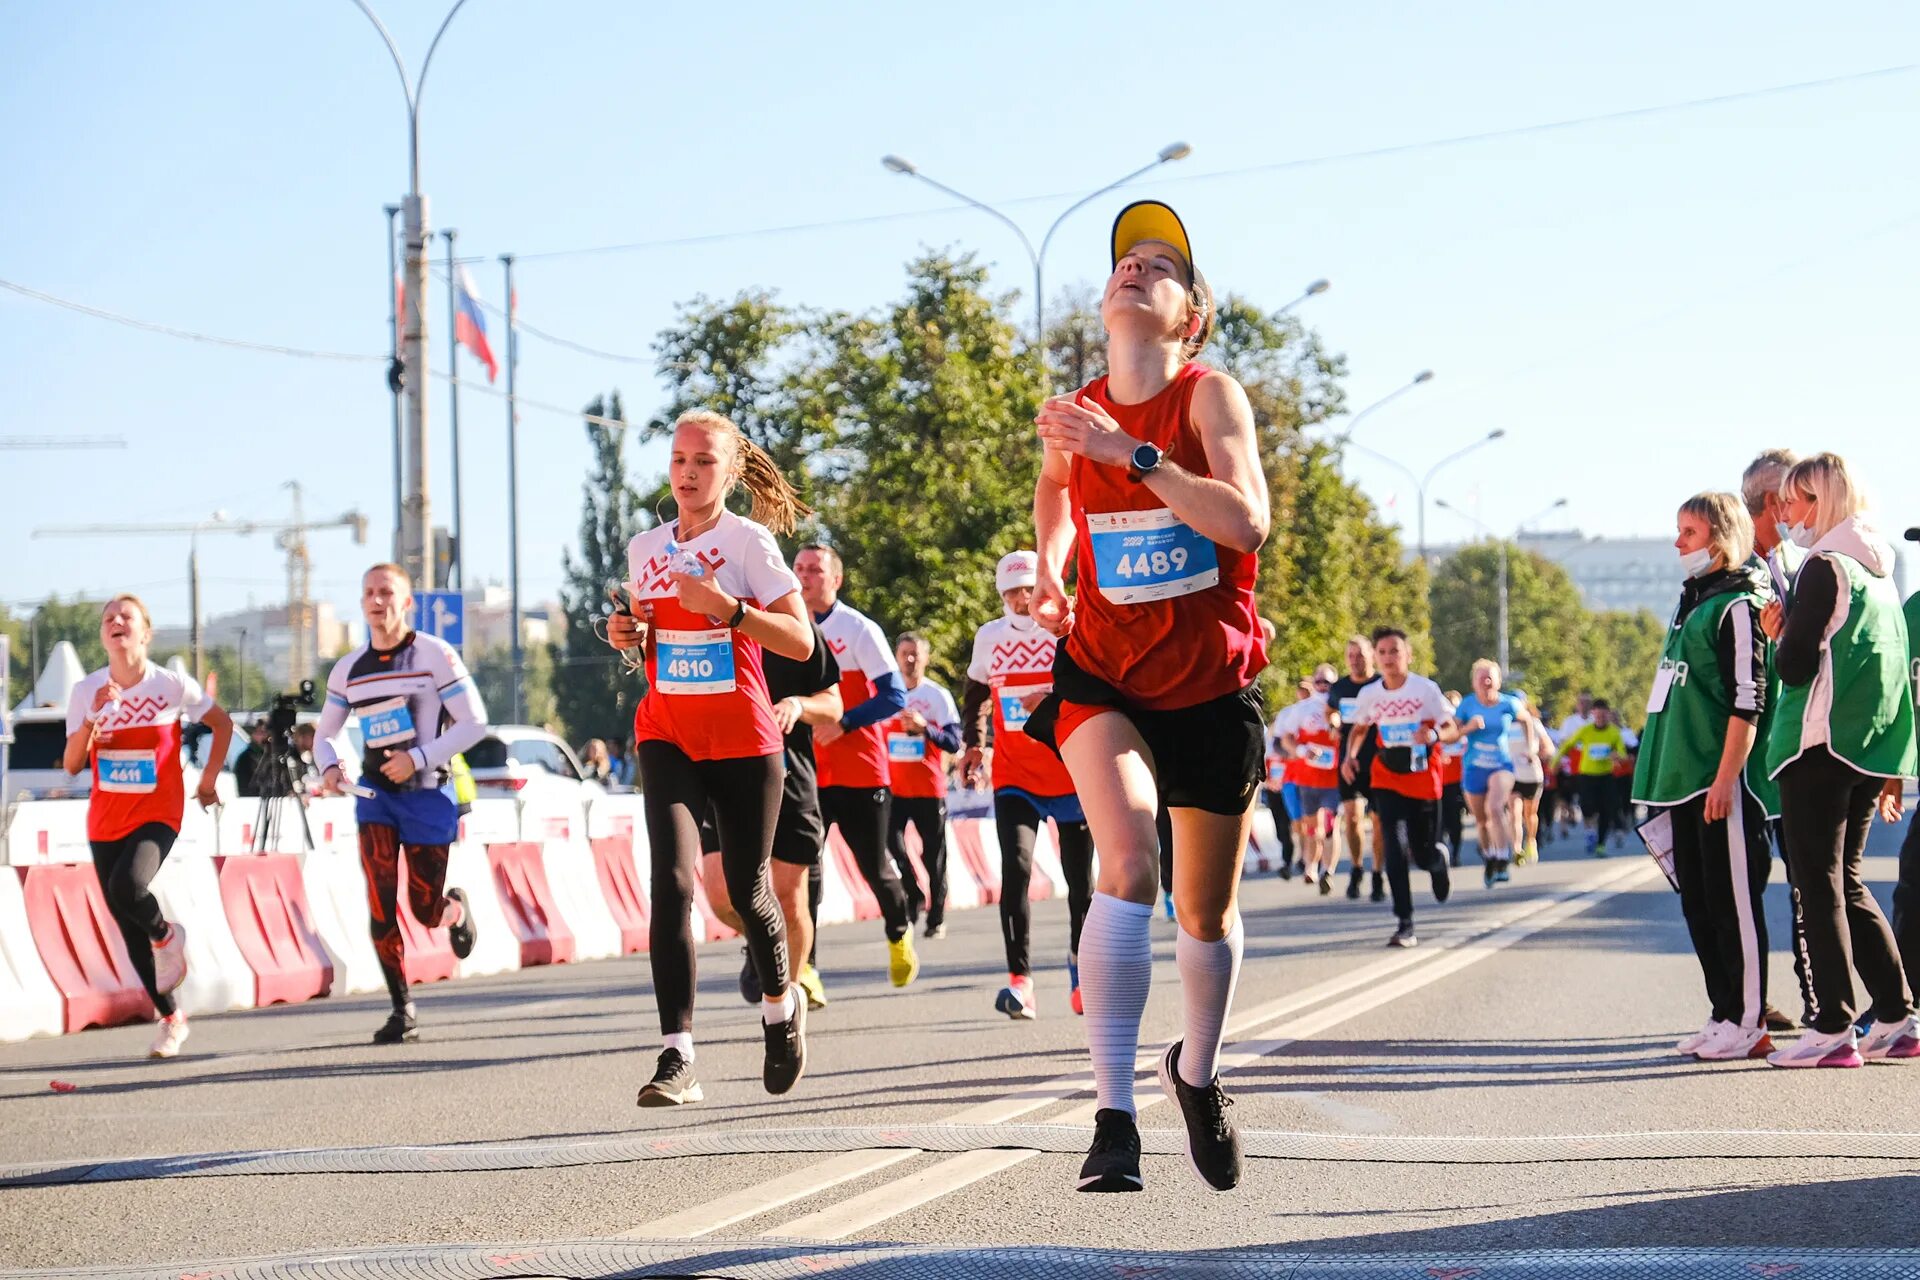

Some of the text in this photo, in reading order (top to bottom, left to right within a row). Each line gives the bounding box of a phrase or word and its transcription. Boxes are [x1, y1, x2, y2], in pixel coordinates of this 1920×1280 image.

[1116, 547, 1188, 579] 4489
[667, 659, 713, 677] 4810
[369, 718, 401, 737] 4783
[109, 768, 142, 782] 4611
[751, 856, 790, 986] KEEP RUNNING
